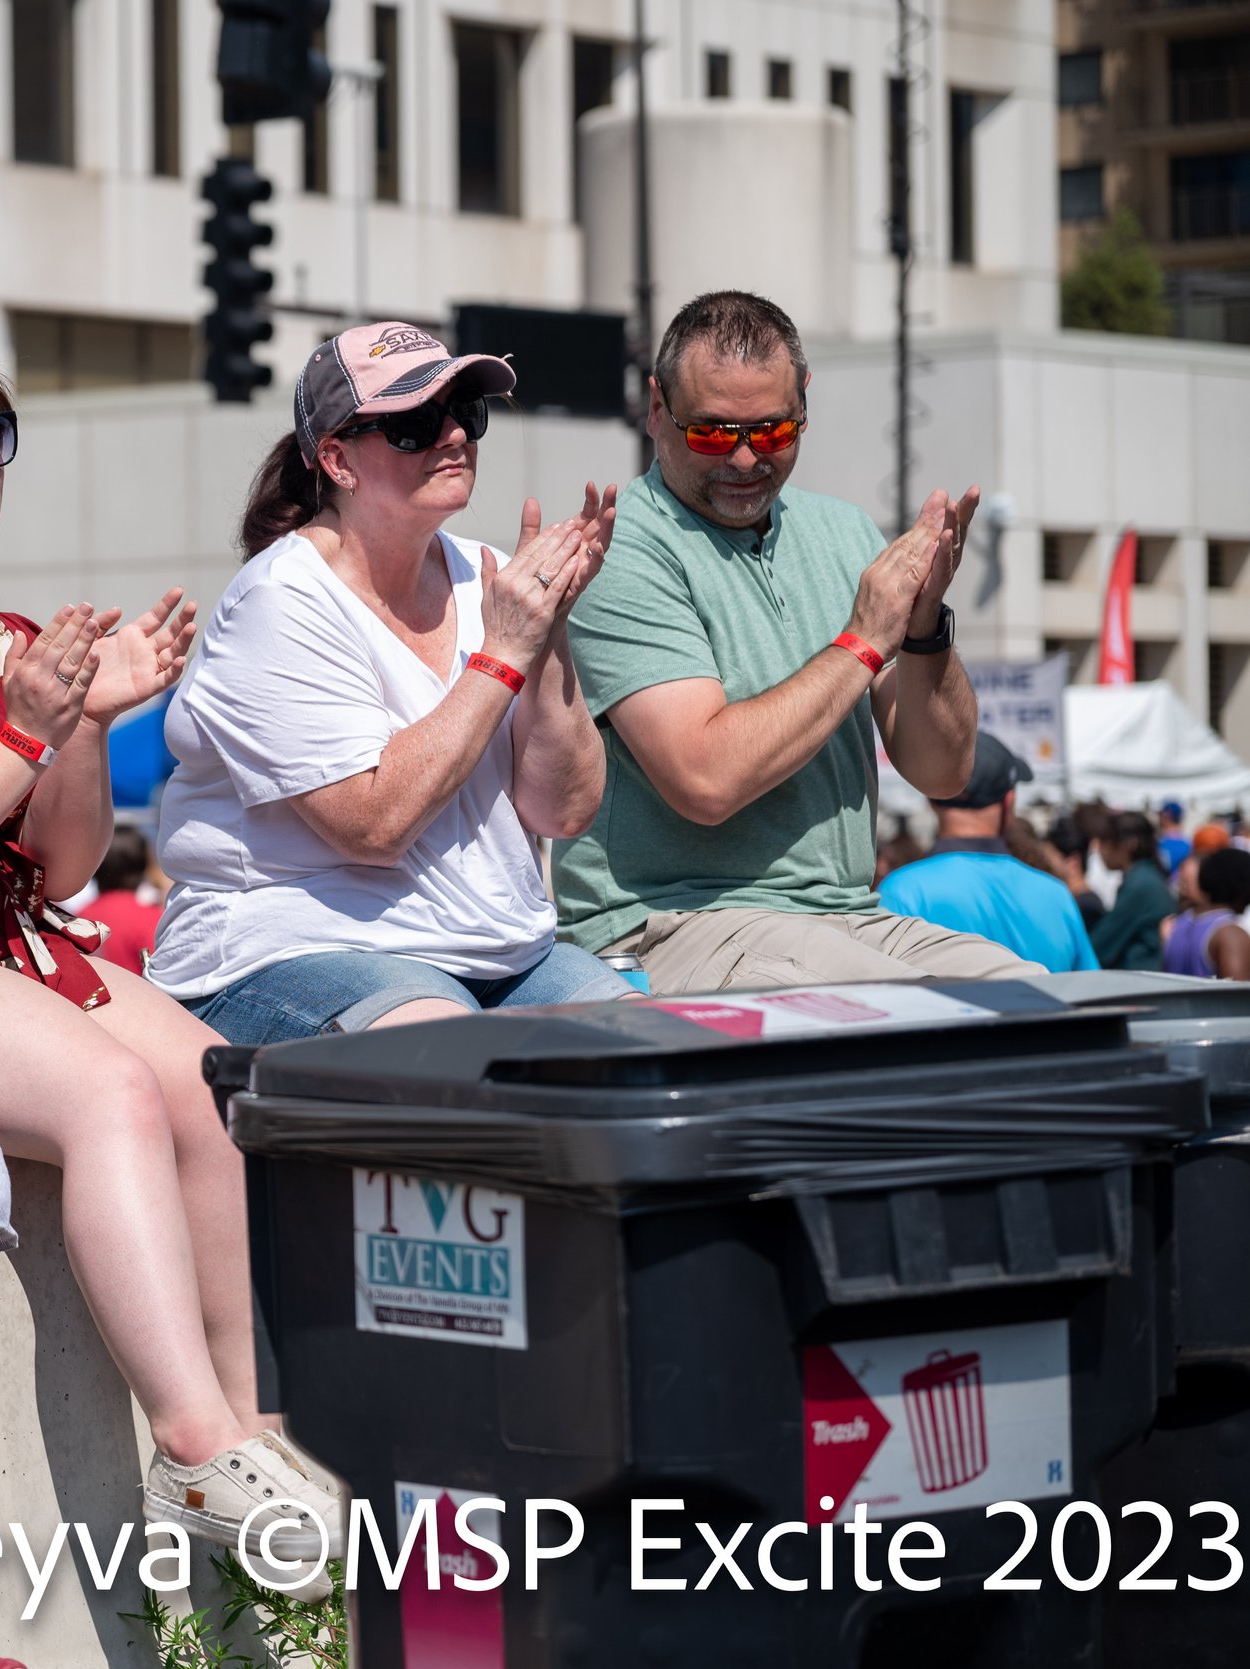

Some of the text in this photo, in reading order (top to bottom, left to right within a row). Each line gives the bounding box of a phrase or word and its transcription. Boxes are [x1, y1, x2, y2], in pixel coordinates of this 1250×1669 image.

[0, 729, 37, 755] SURLY
[367, 1170, 510, 1243] TVG
[370, 1238, 509, 1297] EVENTS
[811, 1415, 870, 1446] Trash
[421, 1543, 480, 1578] Tash
